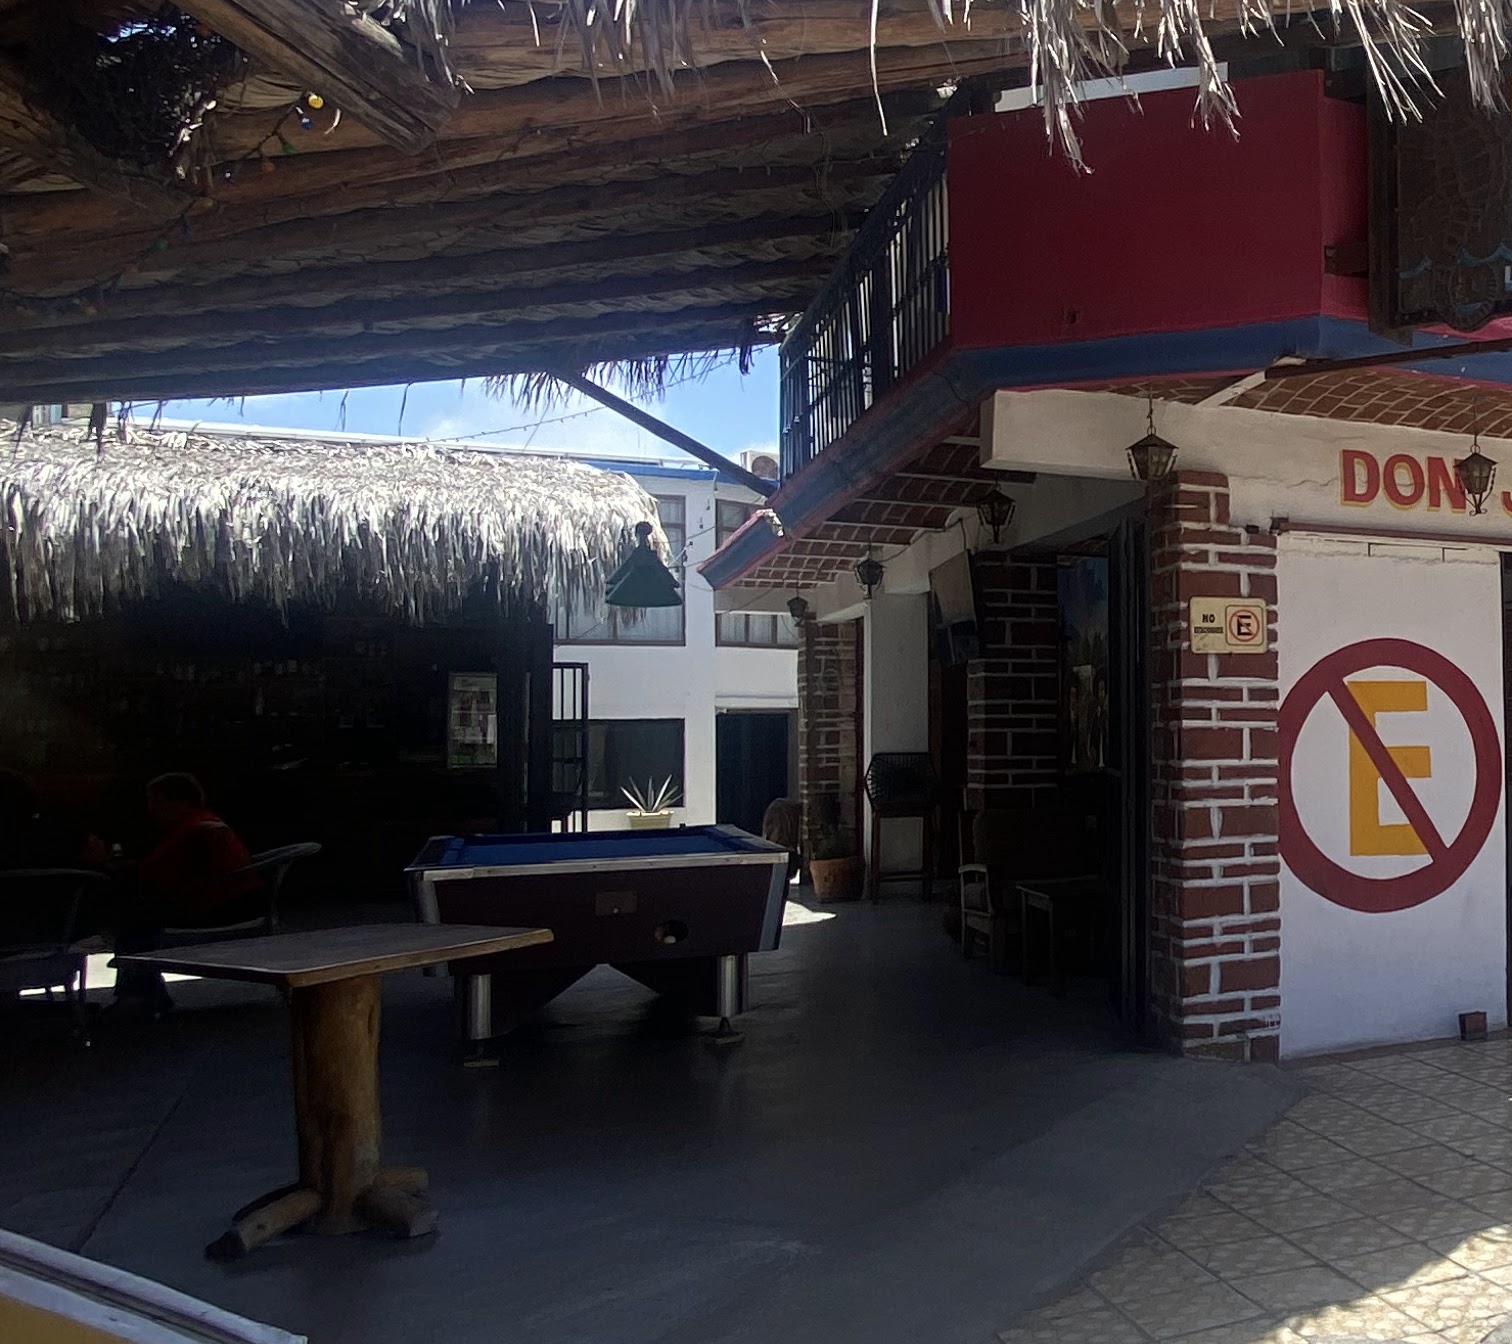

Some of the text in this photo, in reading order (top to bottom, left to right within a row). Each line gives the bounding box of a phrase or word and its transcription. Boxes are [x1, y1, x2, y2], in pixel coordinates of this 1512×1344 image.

[1341, 449, 1467, 513] DON
[1202, 614, 1215, 623] NO
[1348, 681, 1432, 856] E
